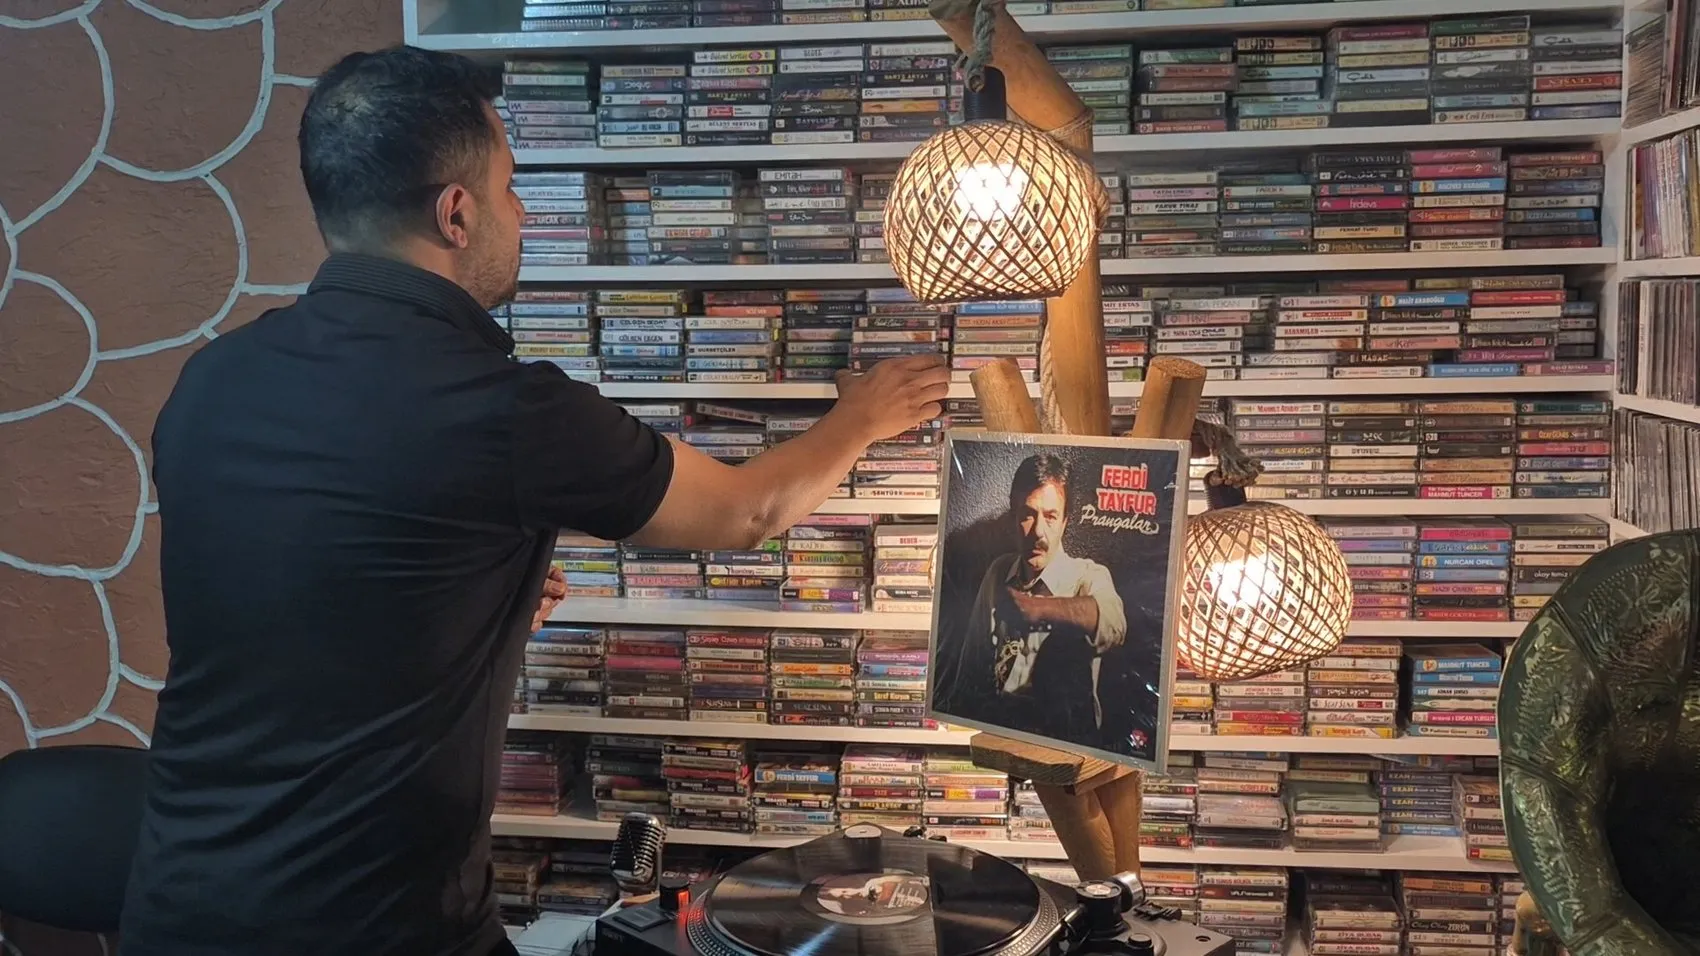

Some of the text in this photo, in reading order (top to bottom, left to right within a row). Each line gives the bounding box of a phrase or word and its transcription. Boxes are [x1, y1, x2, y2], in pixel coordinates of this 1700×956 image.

[1102, 463, 1148, 490] FERDİ
[1096, 488, 1156, 515] TAYFUR
[1079, 504, 1159, 535] Prangalar
